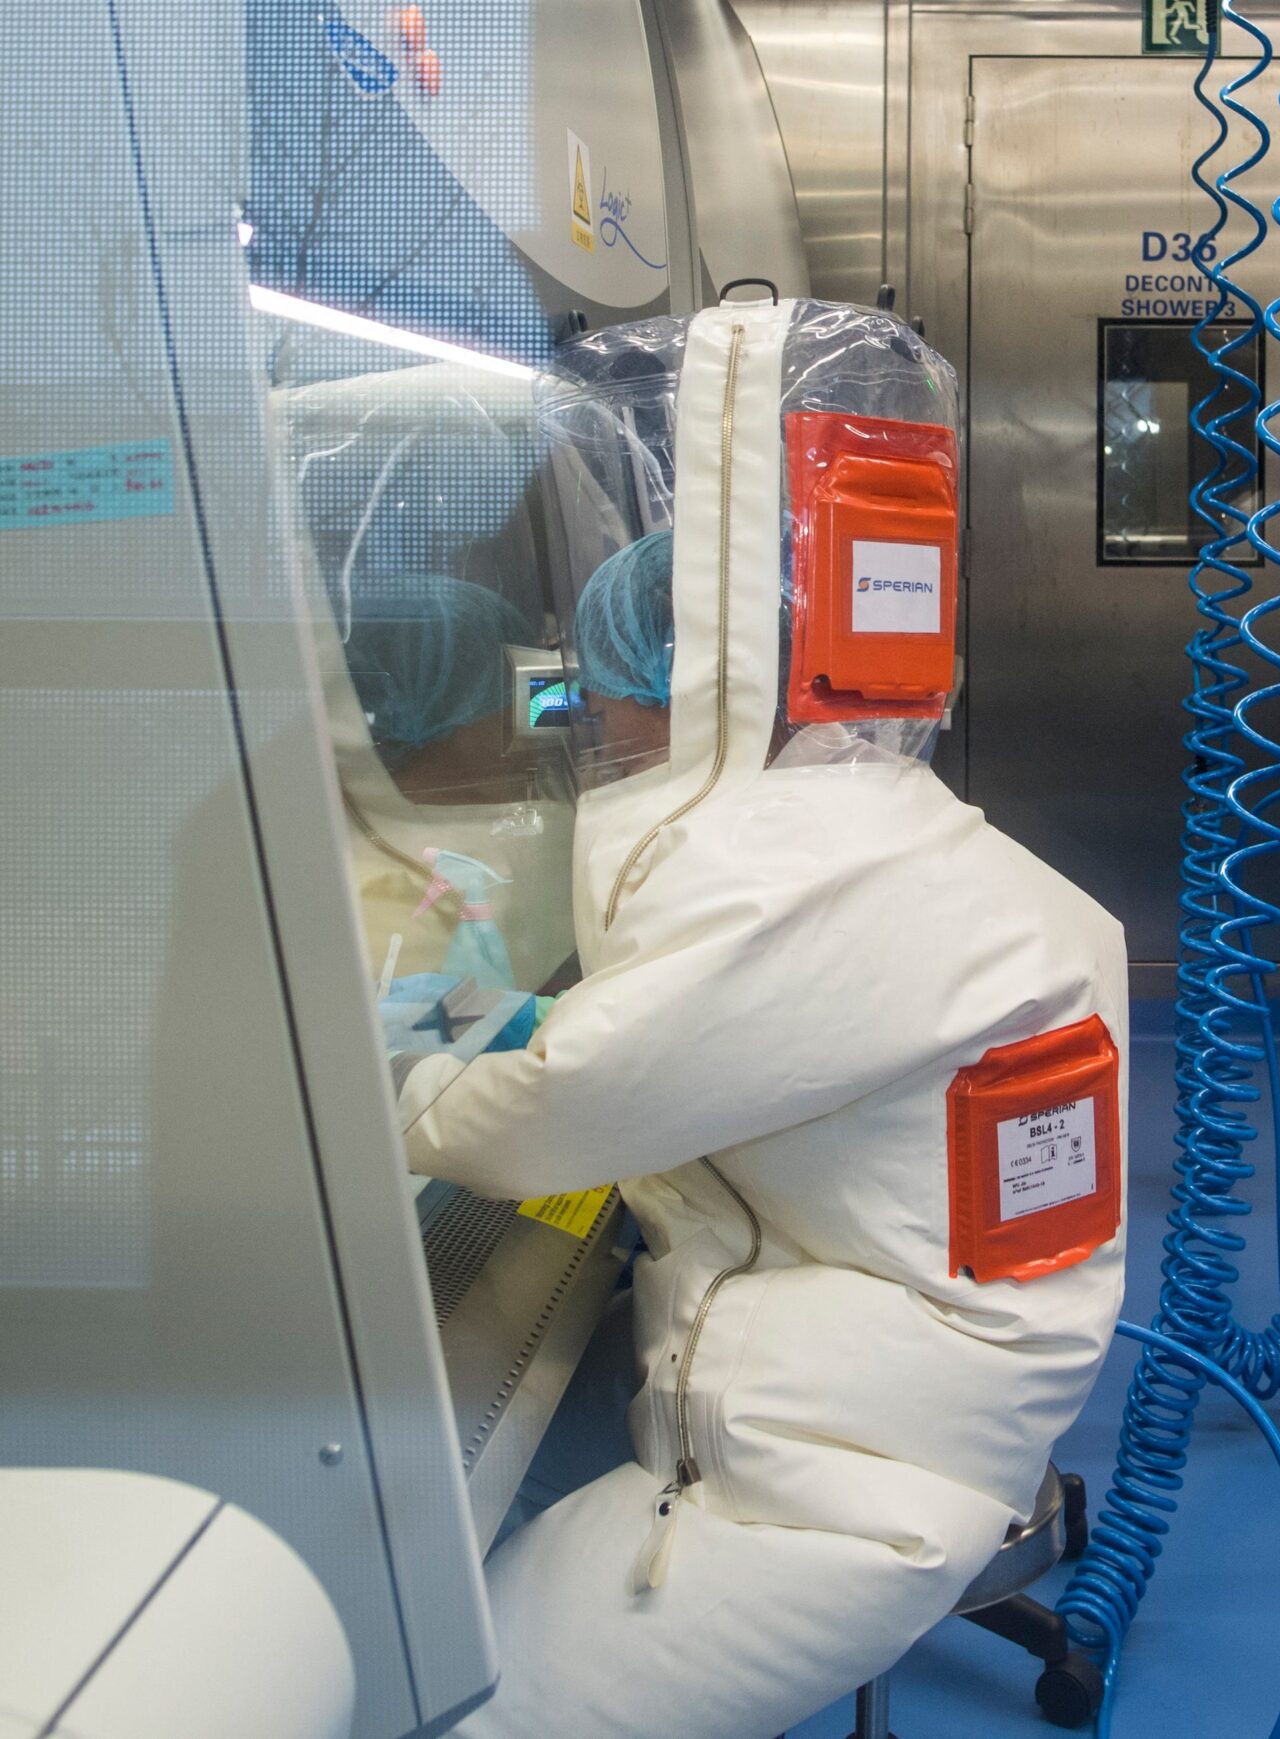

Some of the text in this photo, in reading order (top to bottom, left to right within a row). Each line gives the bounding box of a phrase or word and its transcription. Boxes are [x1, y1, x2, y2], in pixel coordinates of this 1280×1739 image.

[1142, 231, 1217, 262] D36
[1224, 301, 1236, 317] 3
[872, 579, 933, 594] SPERIAN
[1030, 1101, 1077, 1122] SPERIAN
[1029, 1123, 1053, 1139] BSL4
[1059, 1119, 1066, 1131] 2
